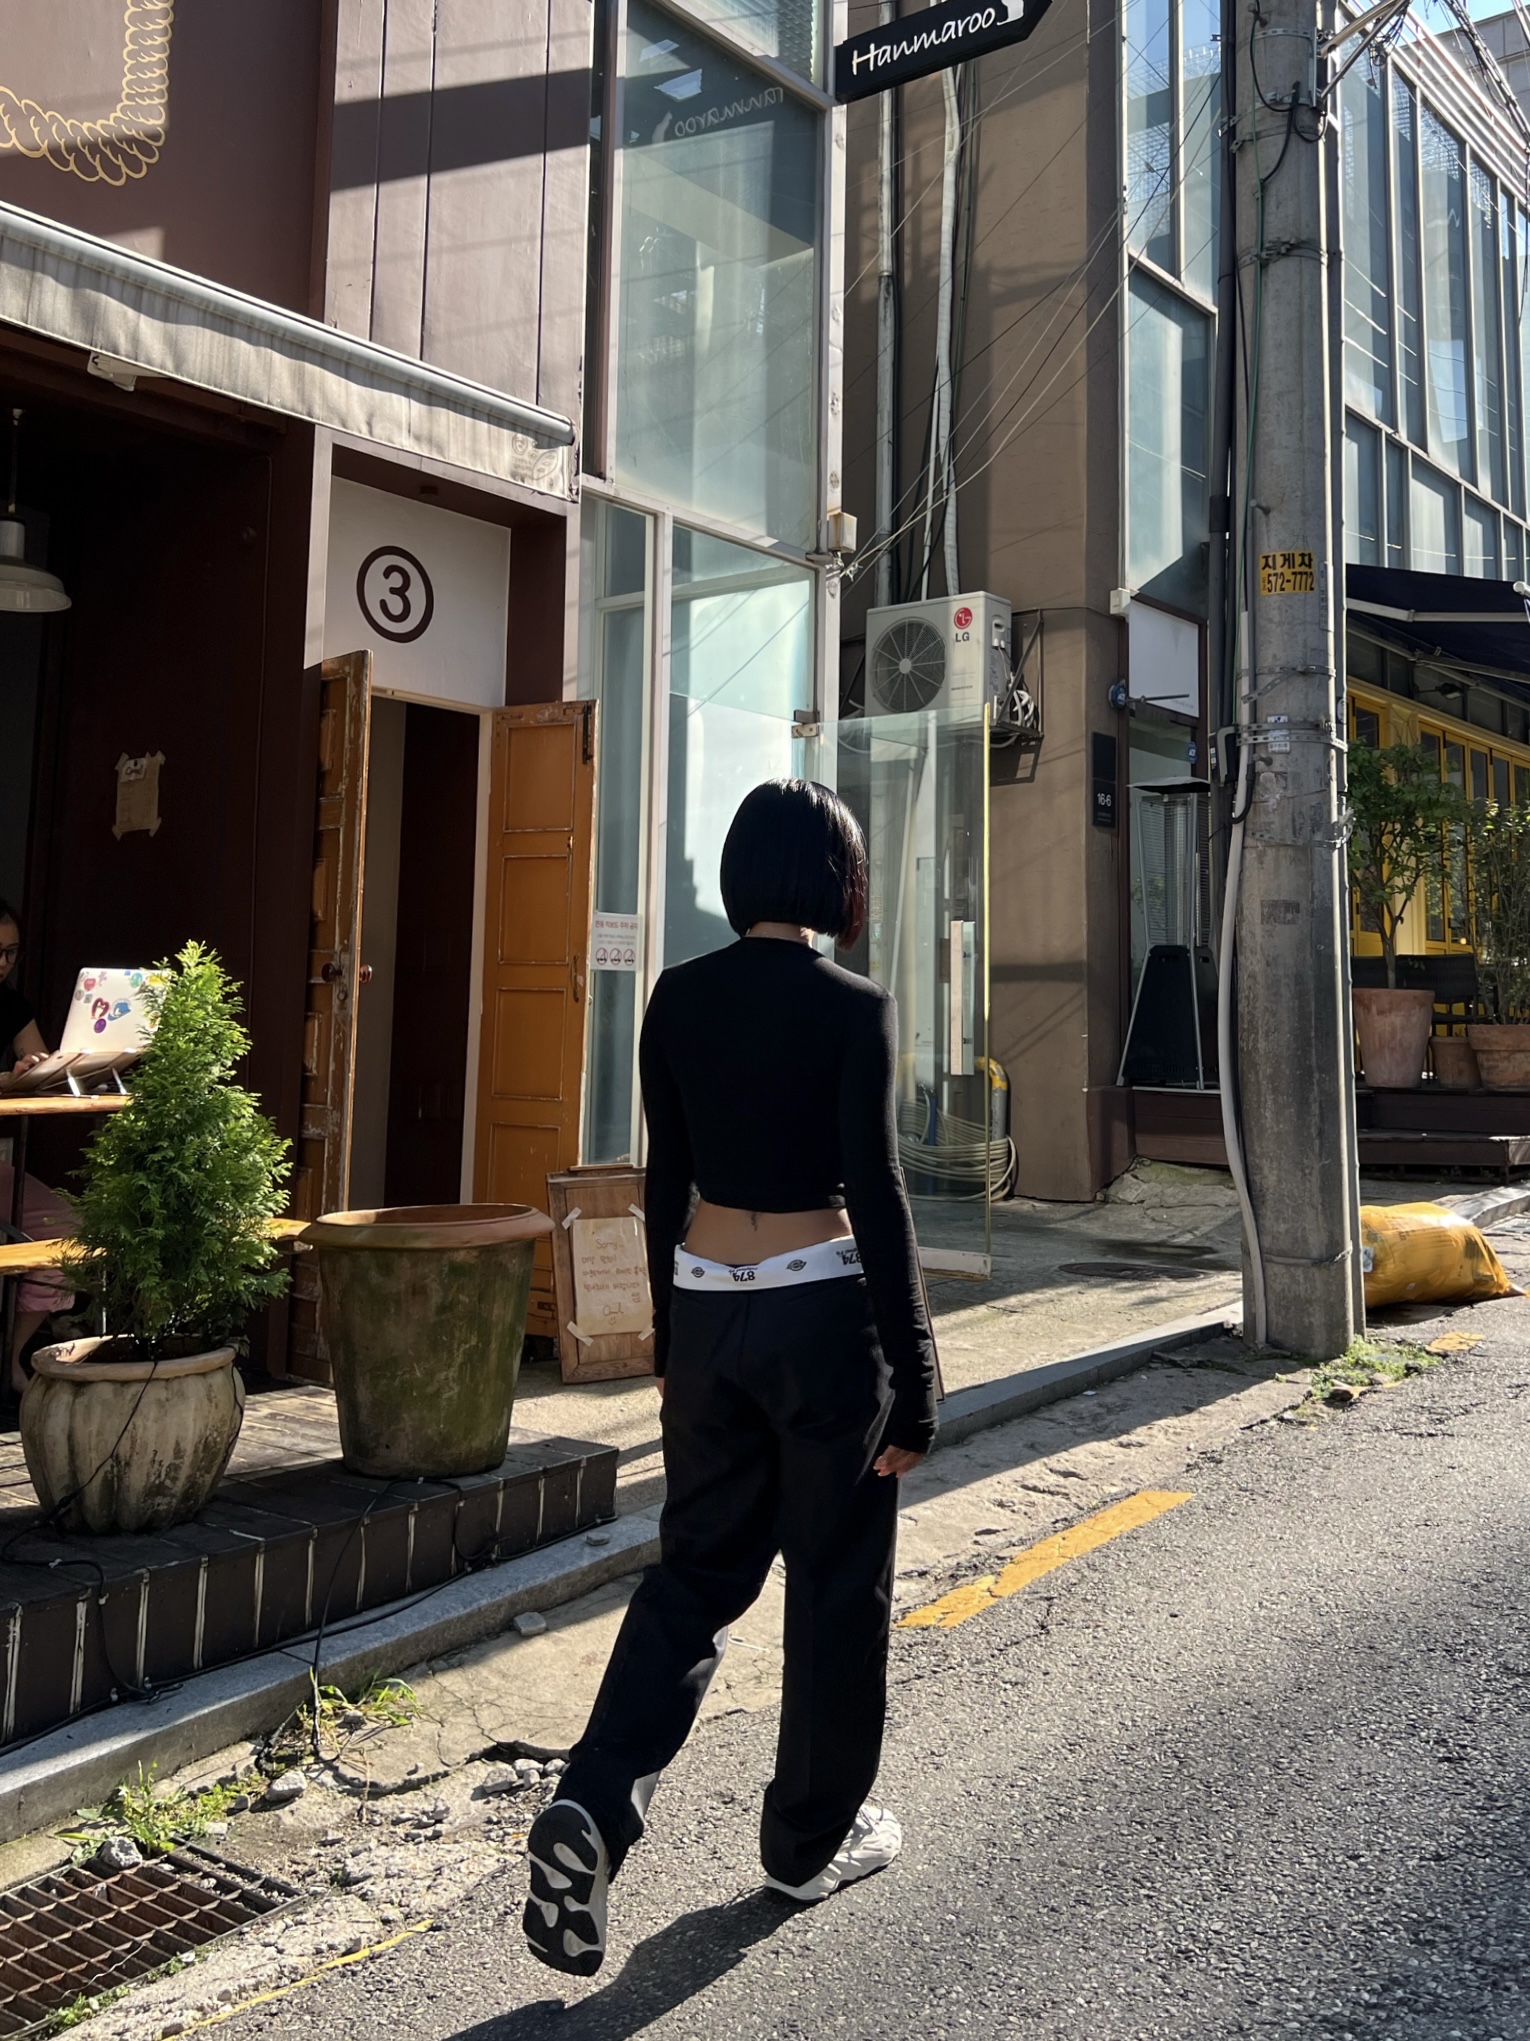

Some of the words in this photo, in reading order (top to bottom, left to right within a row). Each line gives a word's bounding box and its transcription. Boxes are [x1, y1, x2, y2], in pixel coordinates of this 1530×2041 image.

[852, 7, 996, 76] Hanmaroo
[1261, 552, 1313, 571] 지게차
[1267, 571, 1315, 593] 572-7772
[379, 564, 411, 623] 3
[955, 631, 970, 643] LG
[732, 1271, 756, 1282] 874
